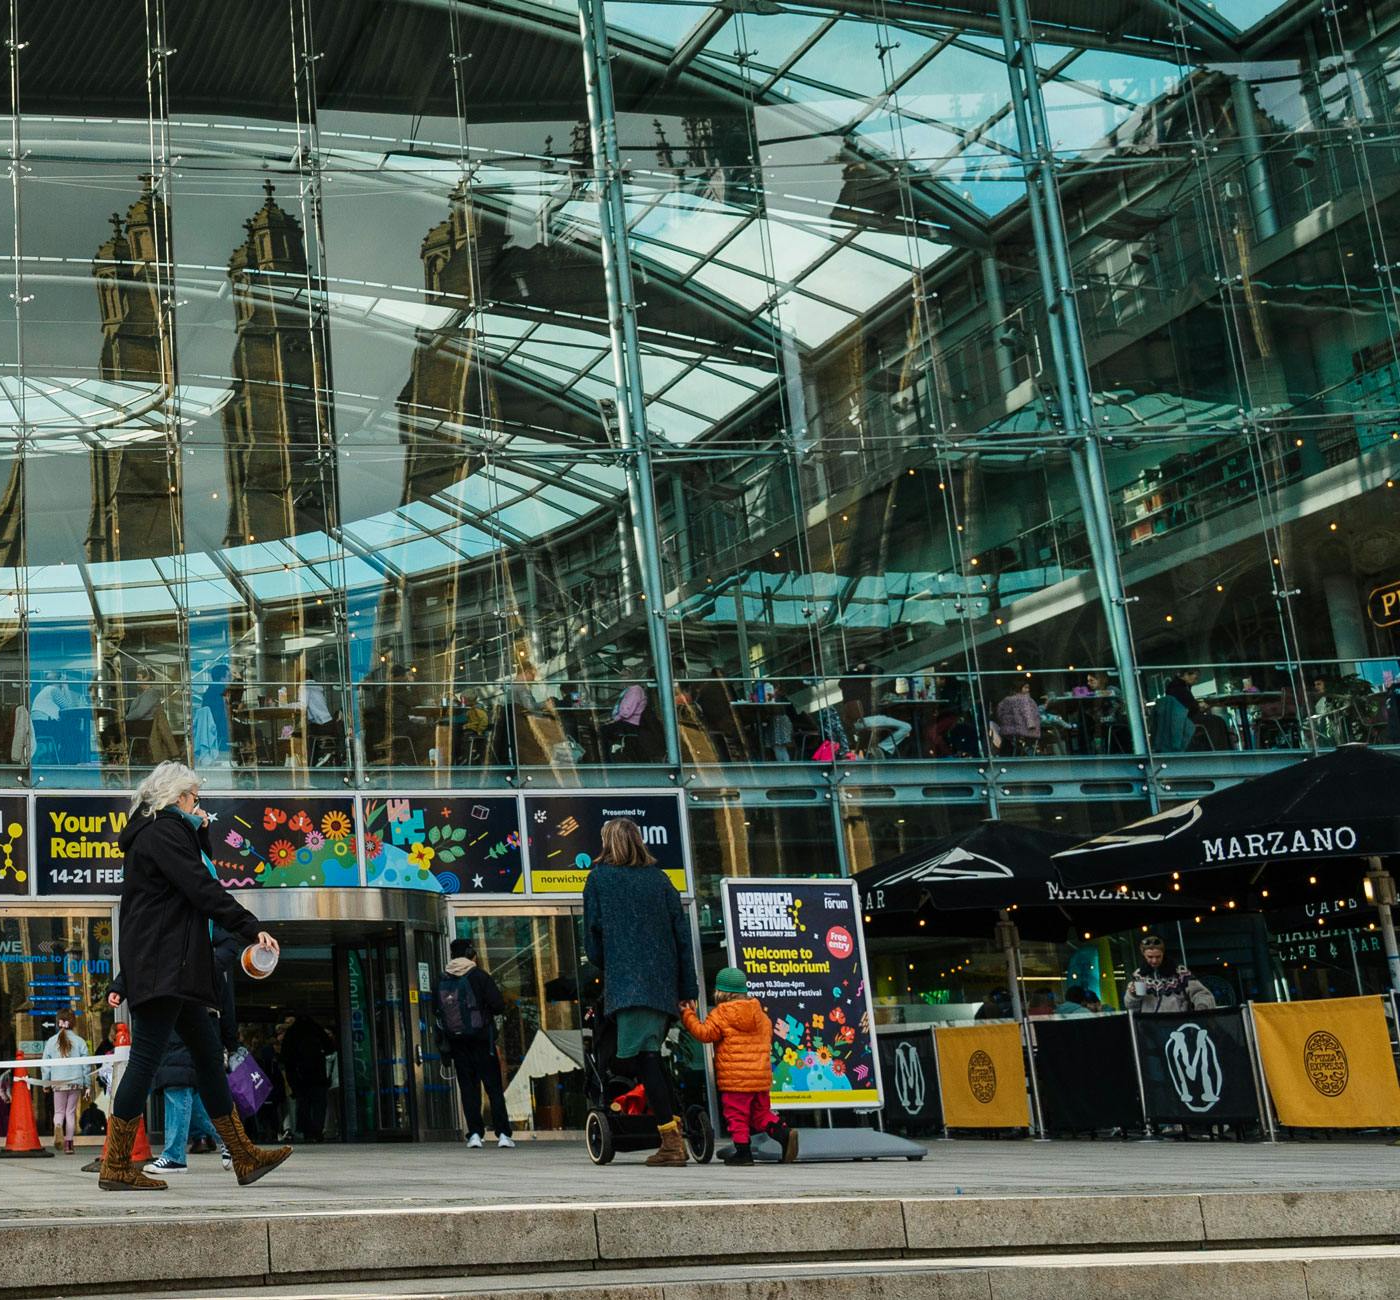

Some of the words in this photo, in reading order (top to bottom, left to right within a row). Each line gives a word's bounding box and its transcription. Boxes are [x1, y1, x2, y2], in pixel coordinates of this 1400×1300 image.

[1381, 590, 1400, 616] P
[602, 808, 636, 816] Presented
[637, 809, 646, 817] by
[49, 811, 106, 833] Your
[50, 836, 125, 858] Reima
[1202, 826, 1357, 862] MARZANO
[49, 869, 92, 884] 14-21
[736, 892, 793, 905] NORWICH
[738, 905, 788, 917] SCIENCE
[739, 917, 797, 930] FESTIVAL
[830, 932, 848, 942] Free
[743, 946, 798, 960] Welcome
[800, 947, 813, 960] to
[828, 941, 850, 952] entry
[0, 954, 47, 963] Welcome
[51, 954, 61, 963] to
[63, 954, 110, 974] forum
[744, 960, 768, 974] The
[769, 961, 831, 977] Explorium!
[766, 990, 779, 998] day
[799, 989, 822, 997] Festival
